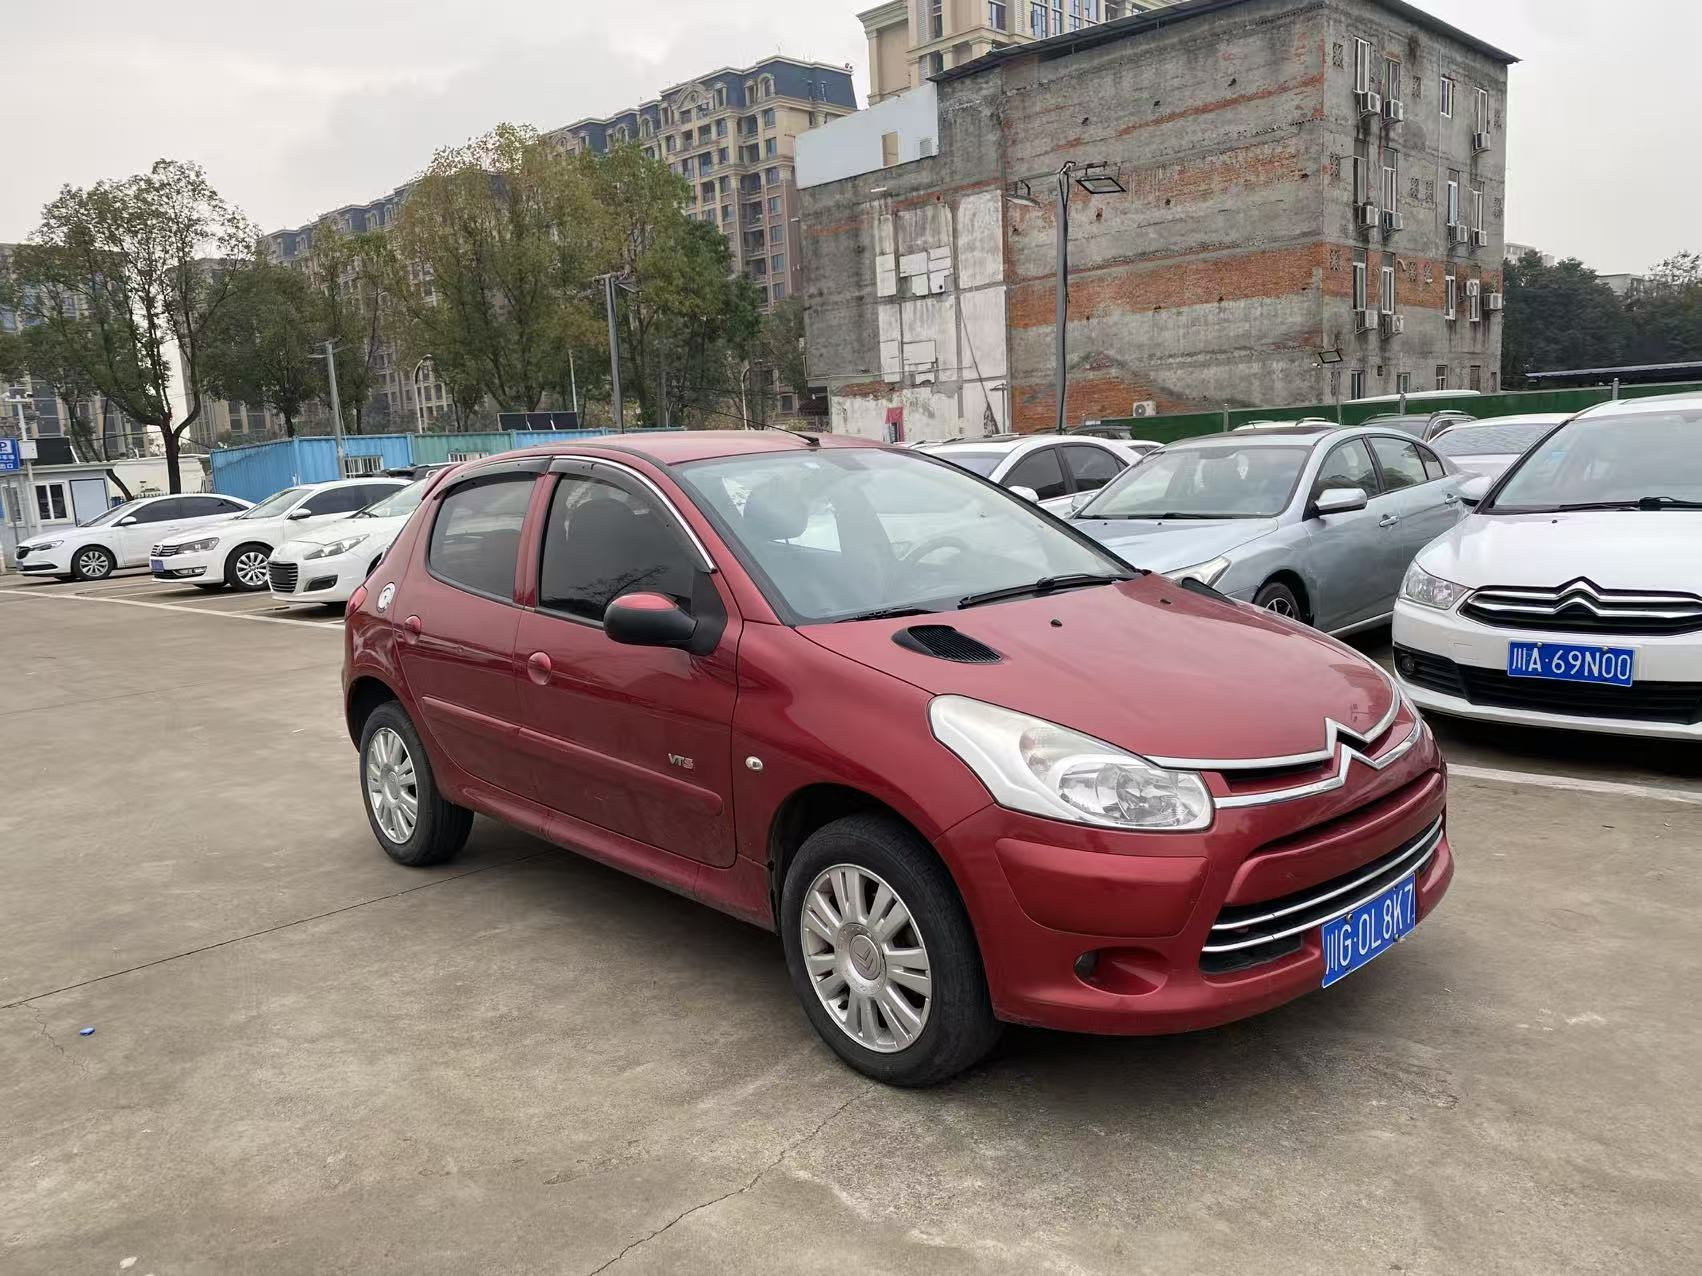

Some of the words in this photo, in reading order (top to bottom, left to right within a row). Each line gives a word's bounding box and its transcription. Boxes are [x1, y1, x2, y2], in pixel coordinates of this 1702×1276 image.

[1511, 647, 1631, 680] 川A·69N00
[668, 753, 694, 770] VTS
[1325, 882, 1414, 975] 川G·0L8K7
